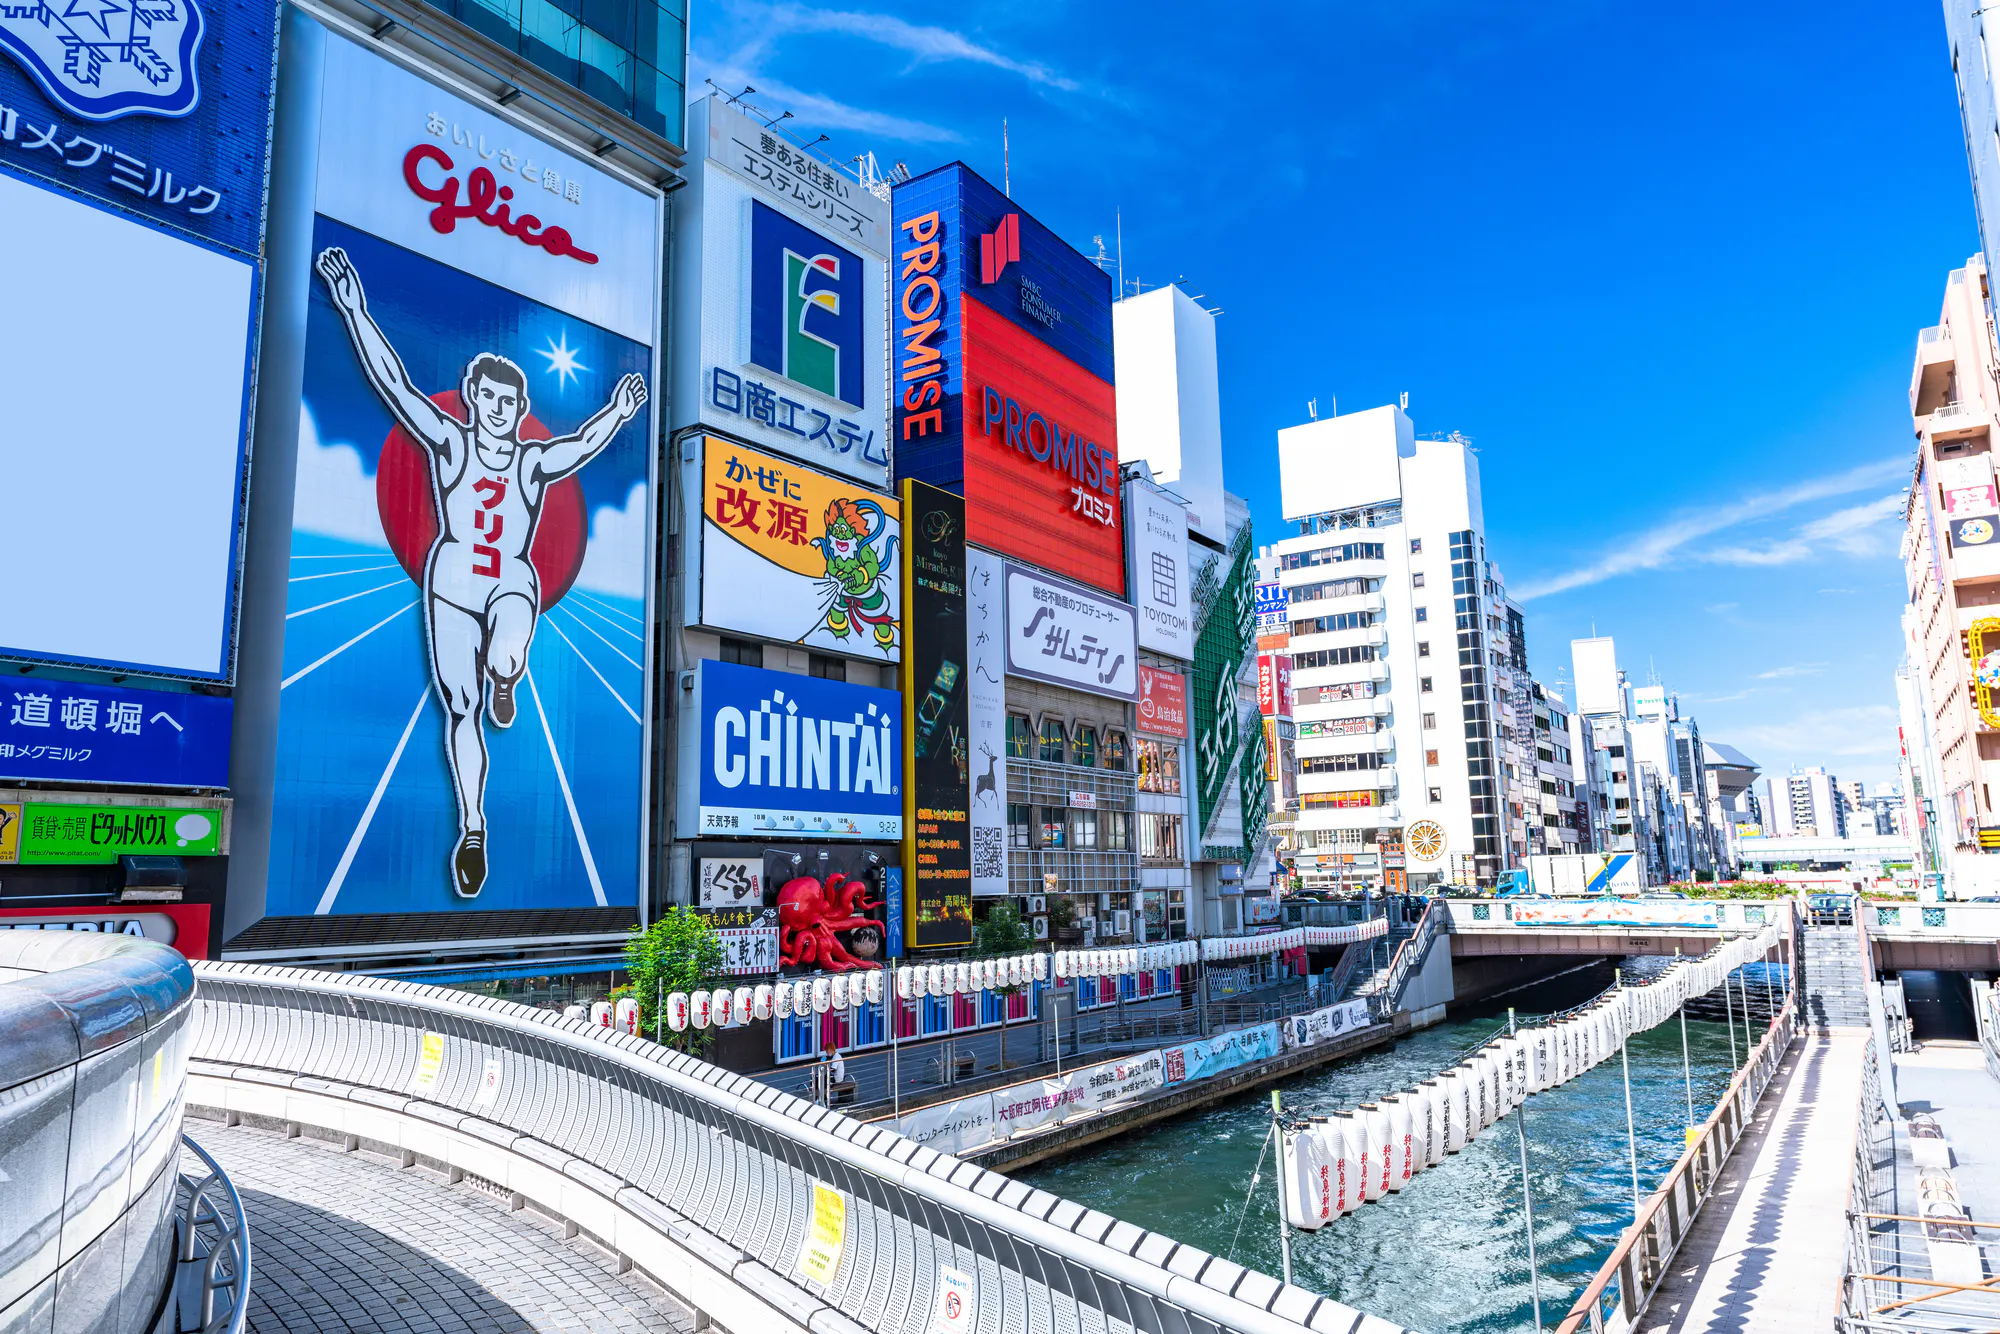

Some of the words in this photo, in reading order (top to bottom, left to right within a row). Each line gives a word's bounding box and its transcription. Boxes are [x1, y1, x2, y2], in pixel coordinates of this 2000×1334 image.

[426, 111, 582, 205] おいしさと健康
[760, 132, 849, 200] 夢ある住まい
[403, 143, 599, 265] Glico
[743, 153, 864, 238] エステムシリーズ
[1021, 275, 1042, 299] SMBC
[1021, 288, 1062, 324] CONSUMER
[902, 210, 943, 441] PROMISE
[1021, 299, 1055, 330] FINANCE
[712, 366, 889, 467] 日商エステム
[984, 385, 1116, 497] PROMISE
[725, 456, 801, 501] かぜに
[472, 476, 509, 579] グリコ
[715, 483, 808, 546] 改源
[1071, 486, 1116, 528] プロミス
[970, 566, 999, 684] はちかん
[1033, 586, 1120, 622] 総合不動産のプロデューサー
[1042, 625, 1109, 668] サムティ
[1155, 626, 1178, 639] HOLDINGS
[1261, 665, 1271, 705] カラオケ
[10, 692, 184, 735] 道頓堀へ
[1201, 662, 1238, 797] エイブル
[714, 689, 892, 795] CHINTAI
[32, 815, 87, 841] 賃貸・売買
[90, 812, 168, 846] ピタットハウス
[706, 814, 740, 829] 天気予報
[917, 824, 938, 834] JAPAN
[917, 854, 939, 864] CHINA
[712, 864, 752, 900] くくる
[944, 894, 967, 908] 高陽社
[766, 919, 777, 927] 2F
[999, 1086, 1085, 1121] 大阪府立阿倍野高等学校
